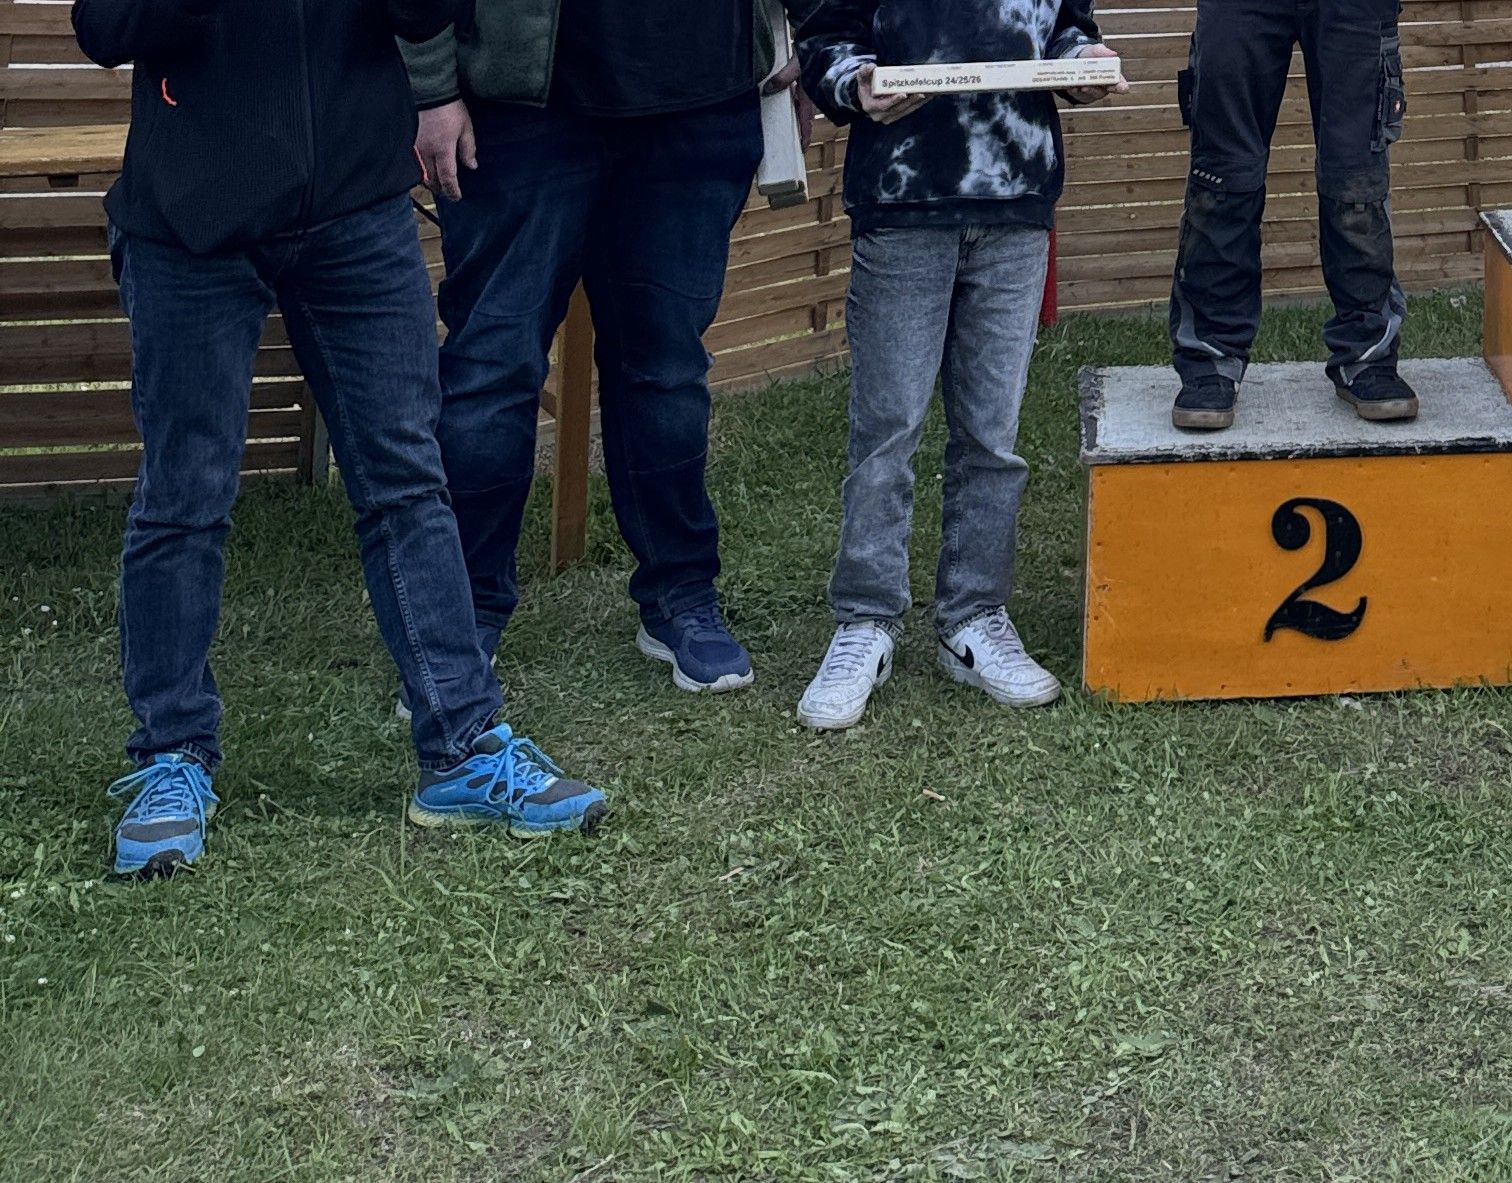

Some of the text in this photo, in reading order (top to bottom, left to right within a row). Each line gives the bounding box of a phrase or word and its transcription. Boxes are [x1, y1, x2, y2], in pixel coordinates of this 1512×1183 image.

[882, 75, 982, 89] Spitzkofelcup 24/25/26
[1264, 496, 1368, 642] 2
